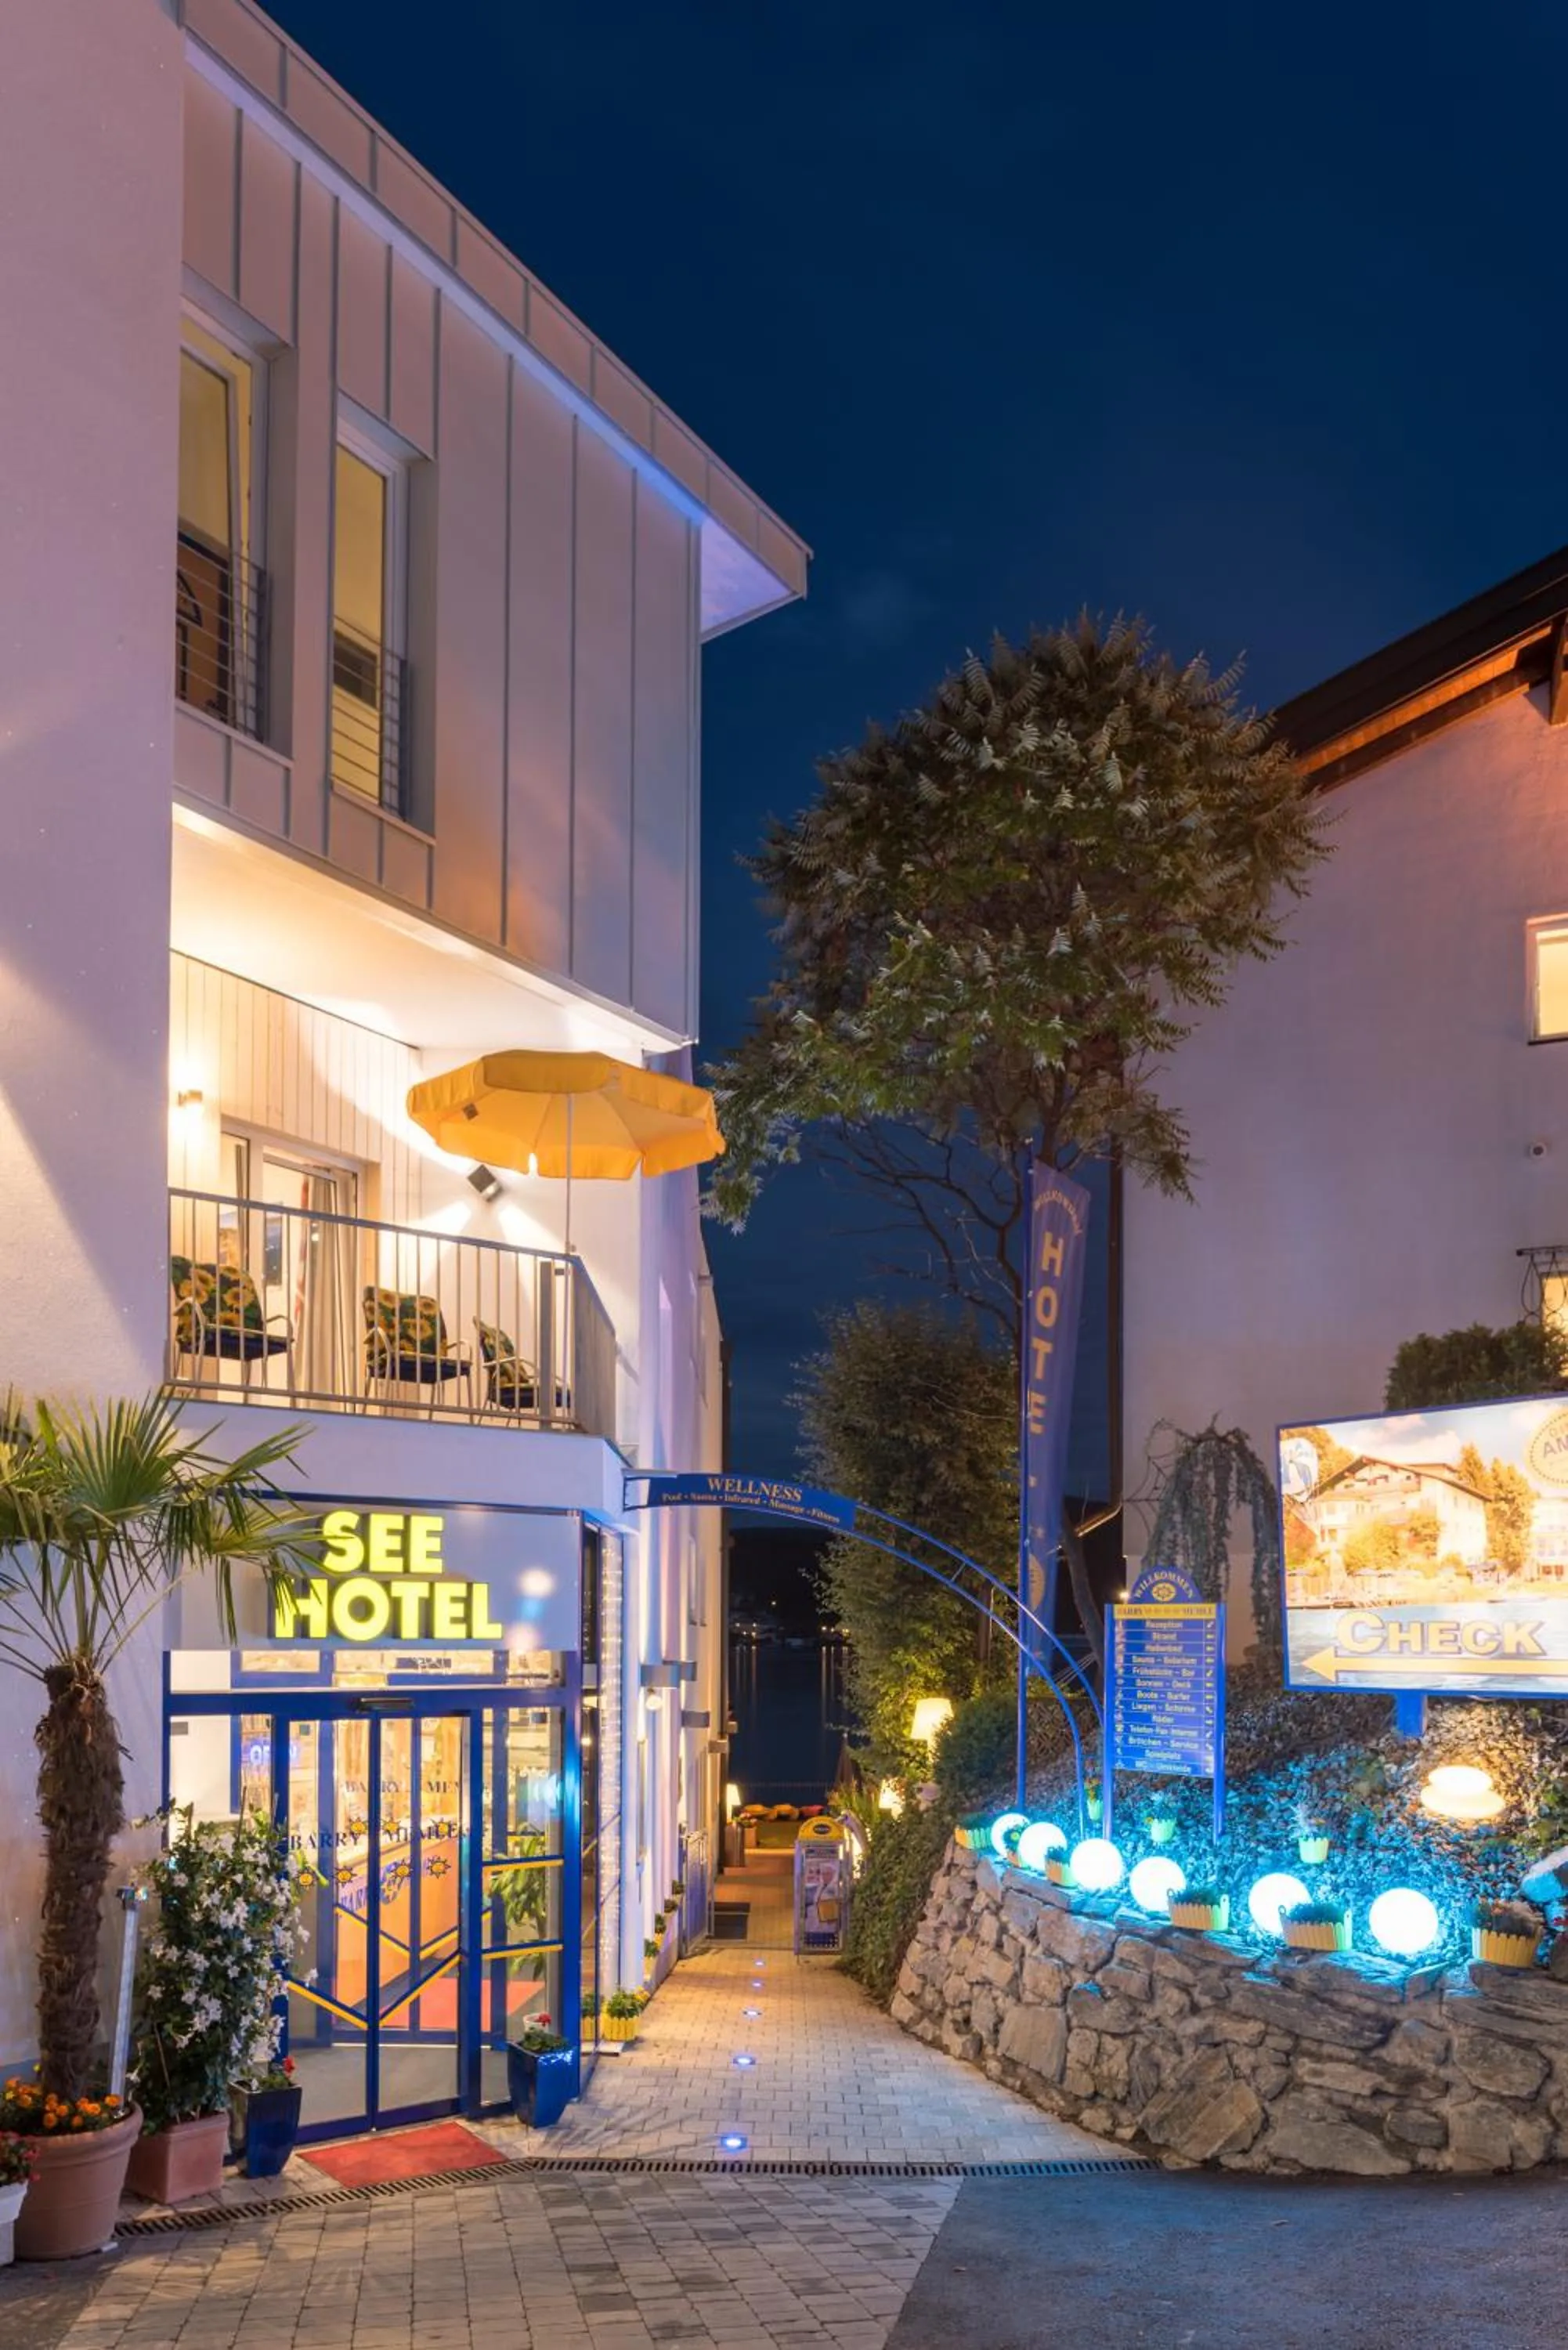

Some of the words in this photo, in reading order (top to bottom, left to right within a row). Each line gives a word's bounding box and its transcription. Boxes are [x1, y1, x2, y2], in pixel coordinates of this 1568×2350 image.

[1028, 1231, 1064, 1488] HOTE
[708, 1477, 802, 1502] WELLNESS
[323, 1510, 443, 1574] SEE
[1134, 1571, 1194, 1599] WILLKOMMEN
[275, 1577, 503, 1641] HOTEL
[1337, 1611, 1547, 1655] CHECK
[251, 1744, 297, 1765] OPN
[291, 1831, 361, 1849] BARRY
